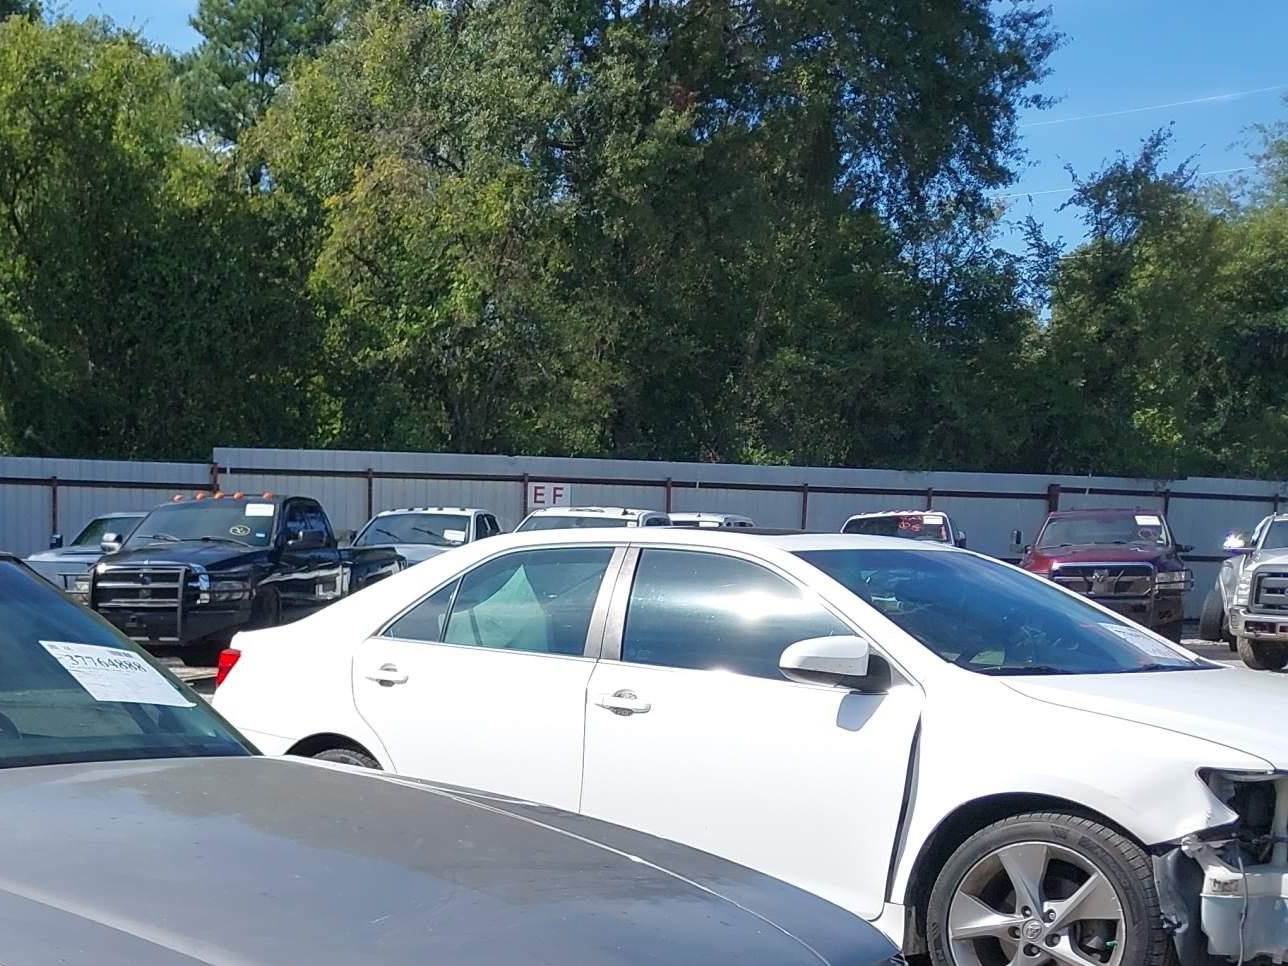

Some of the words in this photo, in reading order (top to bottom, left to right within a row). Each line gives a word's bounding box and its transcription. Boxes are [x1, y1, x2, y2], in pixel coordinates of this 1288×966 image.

[533, 485, 545, 504] E
[552, 486, 564, 505] F
[64, 653, 147, 673] 37764888
